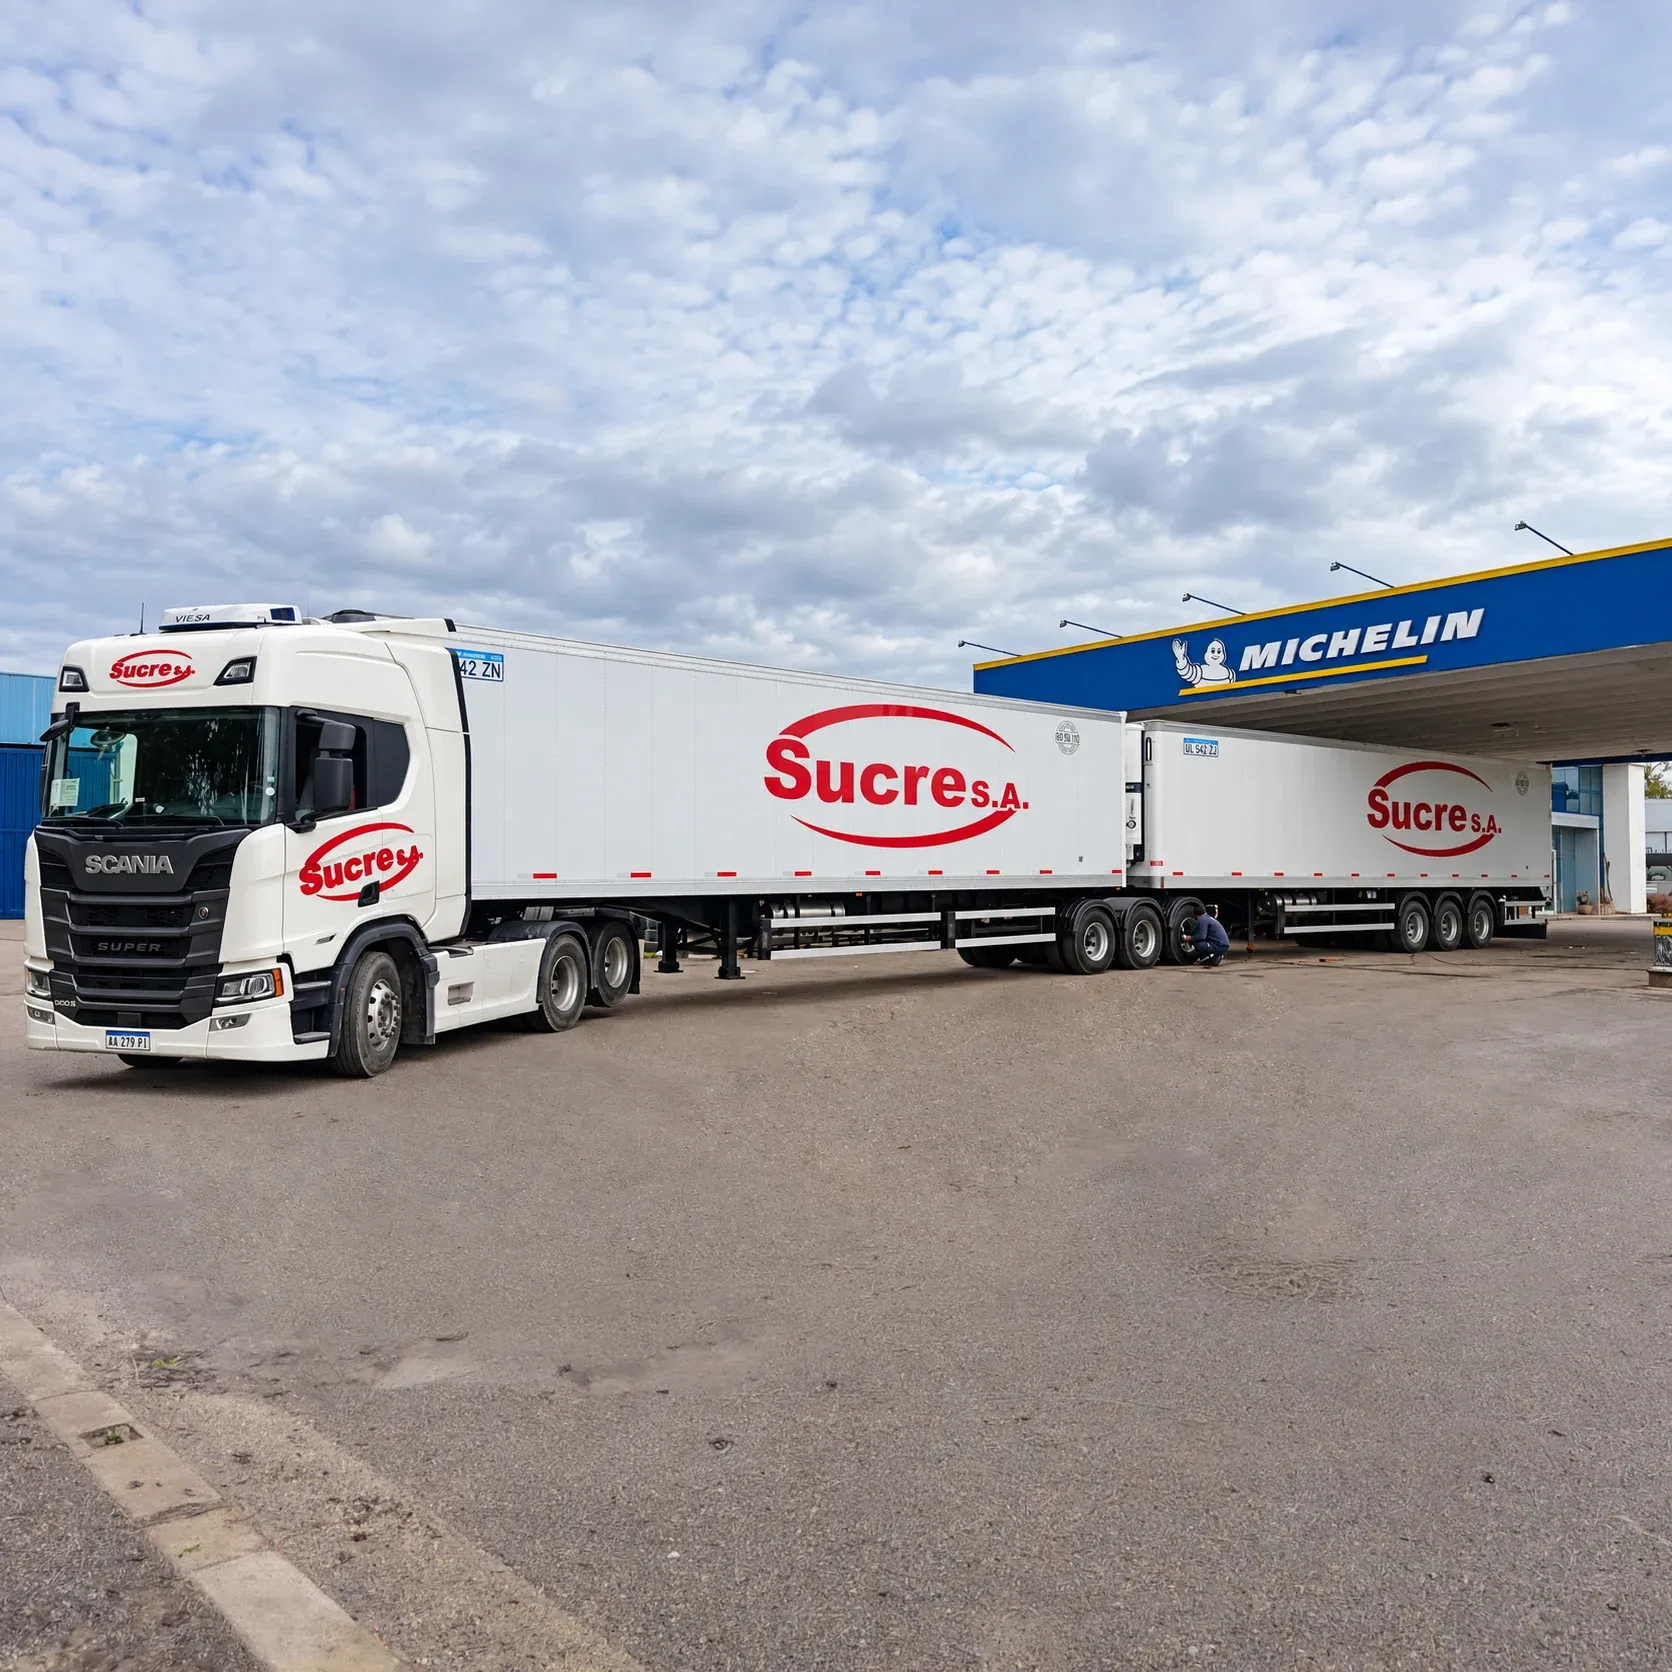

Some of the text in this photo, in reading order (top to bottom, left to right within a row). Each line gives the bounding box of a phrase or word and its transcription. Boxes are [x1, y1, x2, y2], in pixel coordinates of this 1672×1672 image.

[175, 614, 211, 623] VIESA
[1238, 608, 1485, 672] MICHELIN
[109, 661, 172, 679] Sucre
[481, 661, 501, 679] ZN
[764, 738, 1029, 810] Sucre S.A.
[1367, 788, 1502, 834] Sucre S.A.
[85, 854, 174, 874] SCANIA
[298, 848, 394, 896] Sucre
[98, 942, 161, 952] SUPER
[120, 1036, 135, 1048] 279
